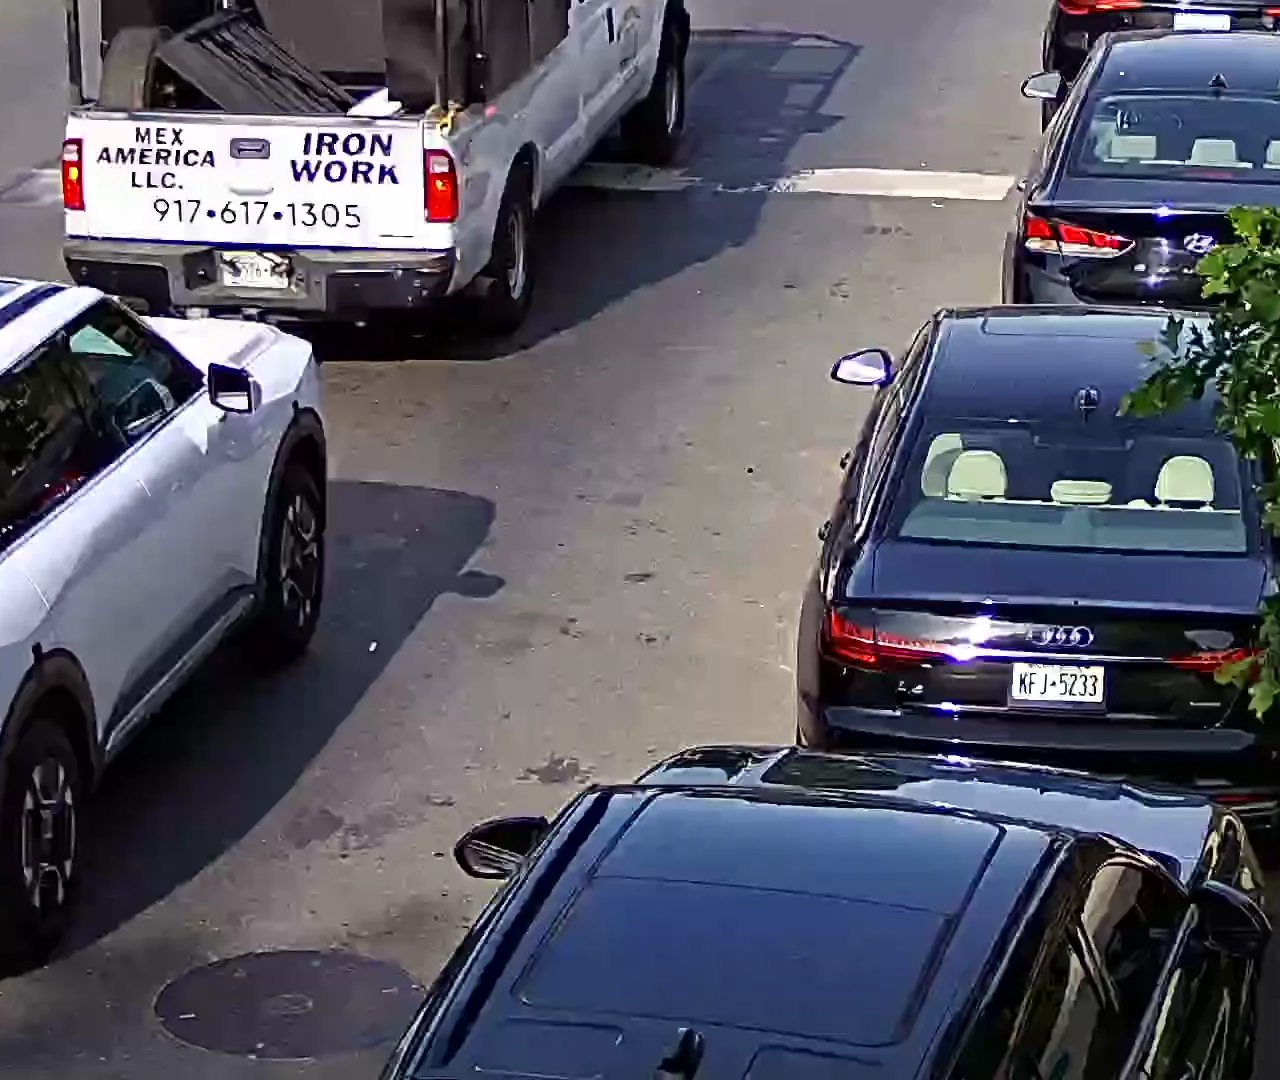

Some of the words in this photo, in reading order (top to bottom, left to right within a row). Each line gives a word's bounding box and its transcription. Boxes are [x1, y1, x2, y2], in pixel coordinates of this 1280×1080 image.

[135, 126, 184, 146] MEX
[303, 131, 394, 157] IRON
[96, 146, 215, 169] AMERICA
[131, 171, 184, 190] LLC.
[291, 159, 400, 186] WORK
